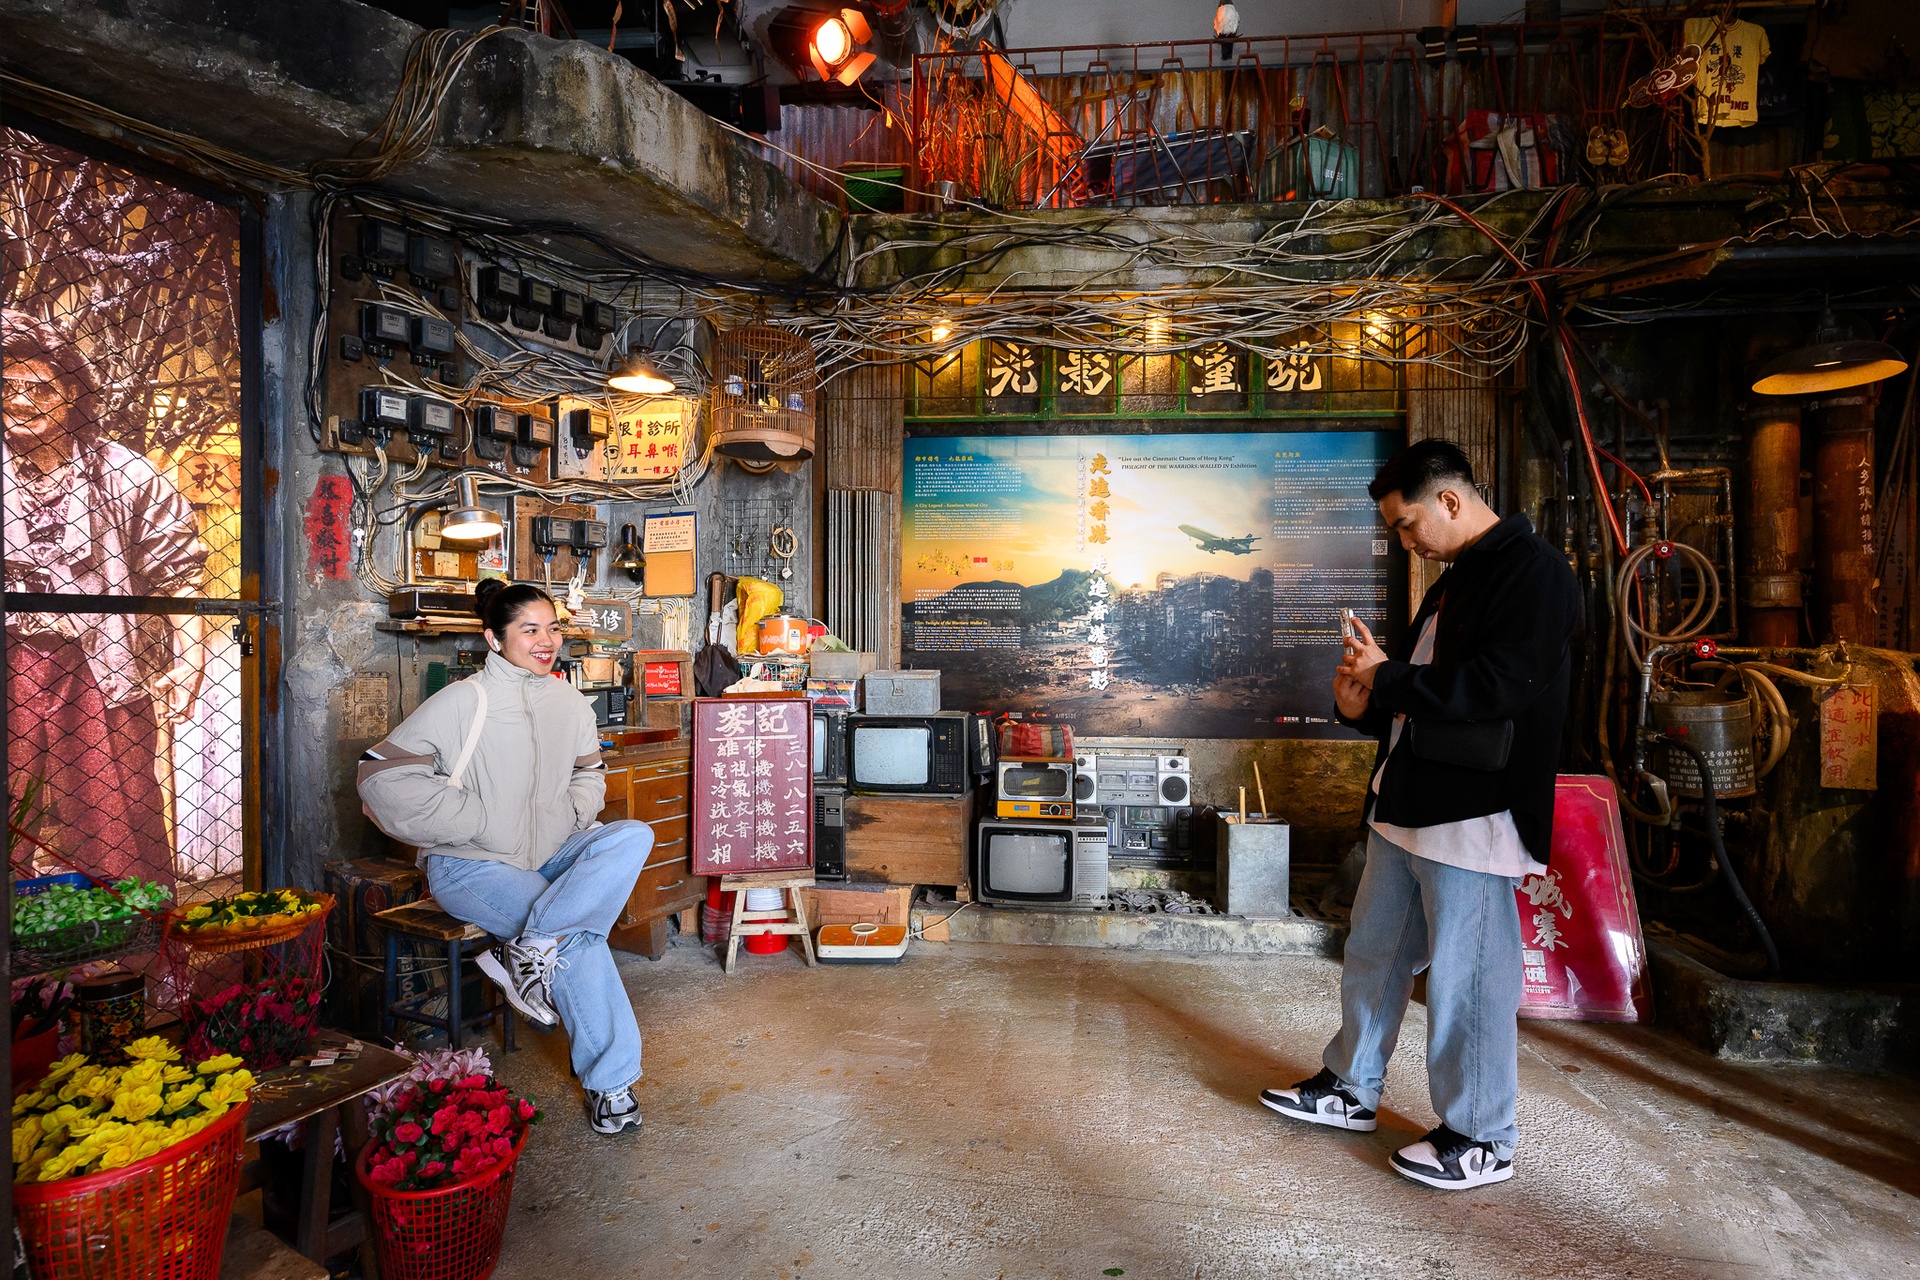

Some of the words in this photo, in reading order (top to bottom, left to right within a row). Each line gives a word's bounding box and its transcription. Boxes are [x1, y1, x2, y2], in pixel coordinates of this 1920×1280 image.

[1709, 43, 1742, 58] 香港
[985, 343, 1113, 397] 光影
[1191, 342, 1322, 397] 重現
[647, 420, 680, 437] 診所
[627, 443, 678, 459] 耳鼻喉
[191, 463, 230, 493] 秋
[1088, 453, 1111, 544] 走進香港
[1088, 556, 1110, 691] 走進香港電影
[1851, 689, 1872, 747] 此井水
[1824, 689, 1848, 782] 不適宜飲用
[717, 739, 766, 758] 維修
[710, 759, 775, 780] 電視機
[710, 778, 775, 799] 冷氣機
[784, 740, 806, 855] 三八一八二五六
[709, 799, 776, 819] 洗衣機
[710, 820, 777, 839] 收音機
[1521, 869, 1573, 951] 城寨
